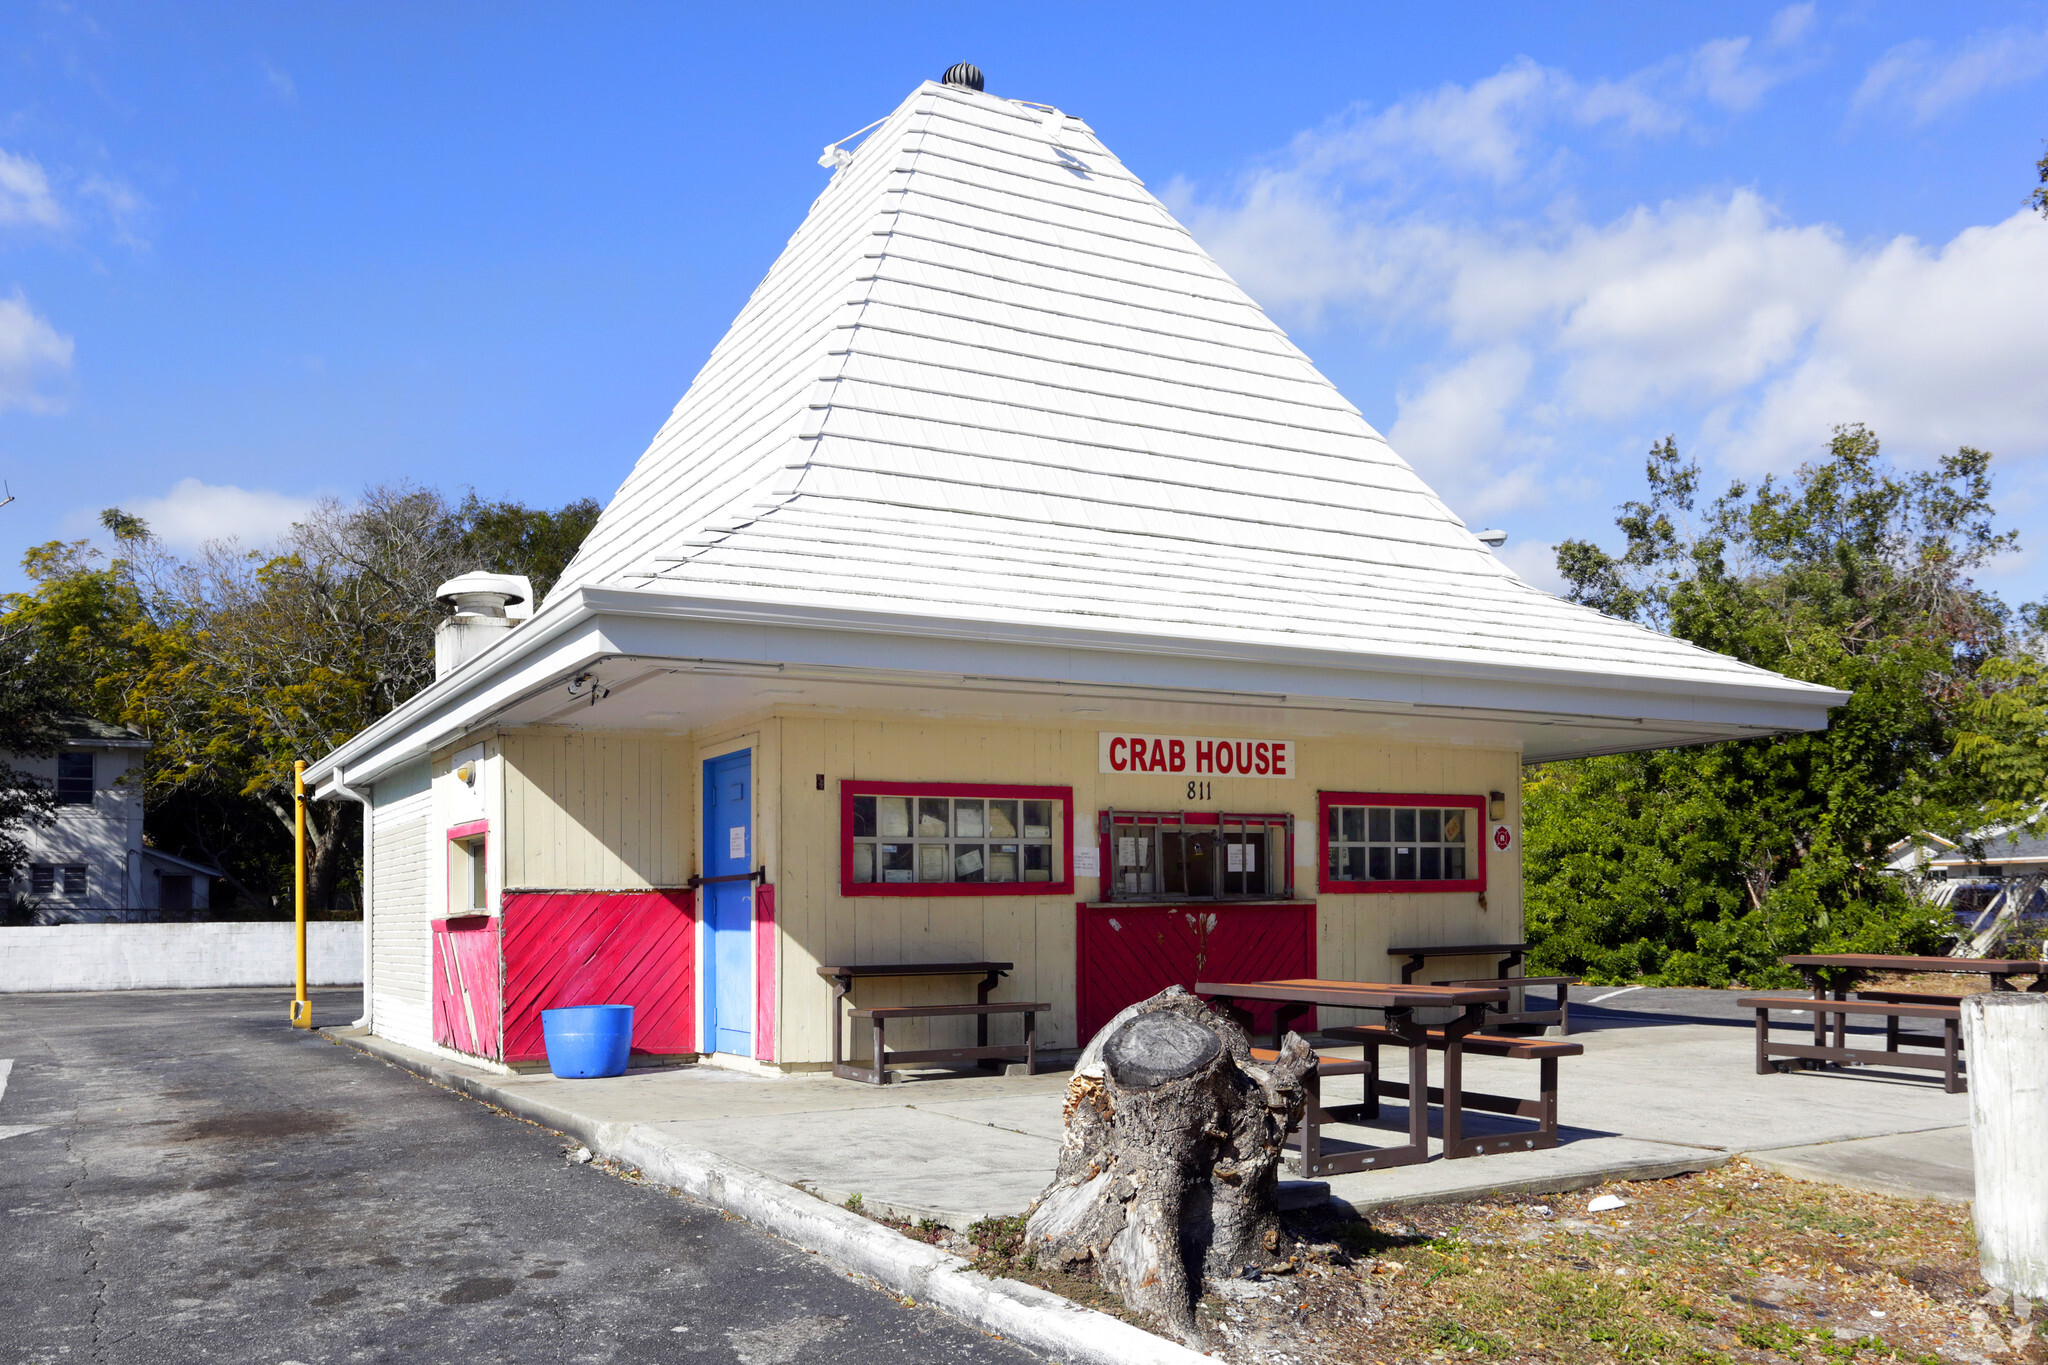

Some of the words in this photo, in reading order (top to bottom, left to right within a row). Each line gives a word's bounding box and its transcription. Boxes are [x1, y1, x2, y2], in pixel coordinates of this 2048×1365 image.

[1109, 737, 1186, 772] CRAB
[1195, 740, 1287, 775] HOUSE
[1187, 780, 1212, 801] 811
[1500, 834, 1505, 842] R
